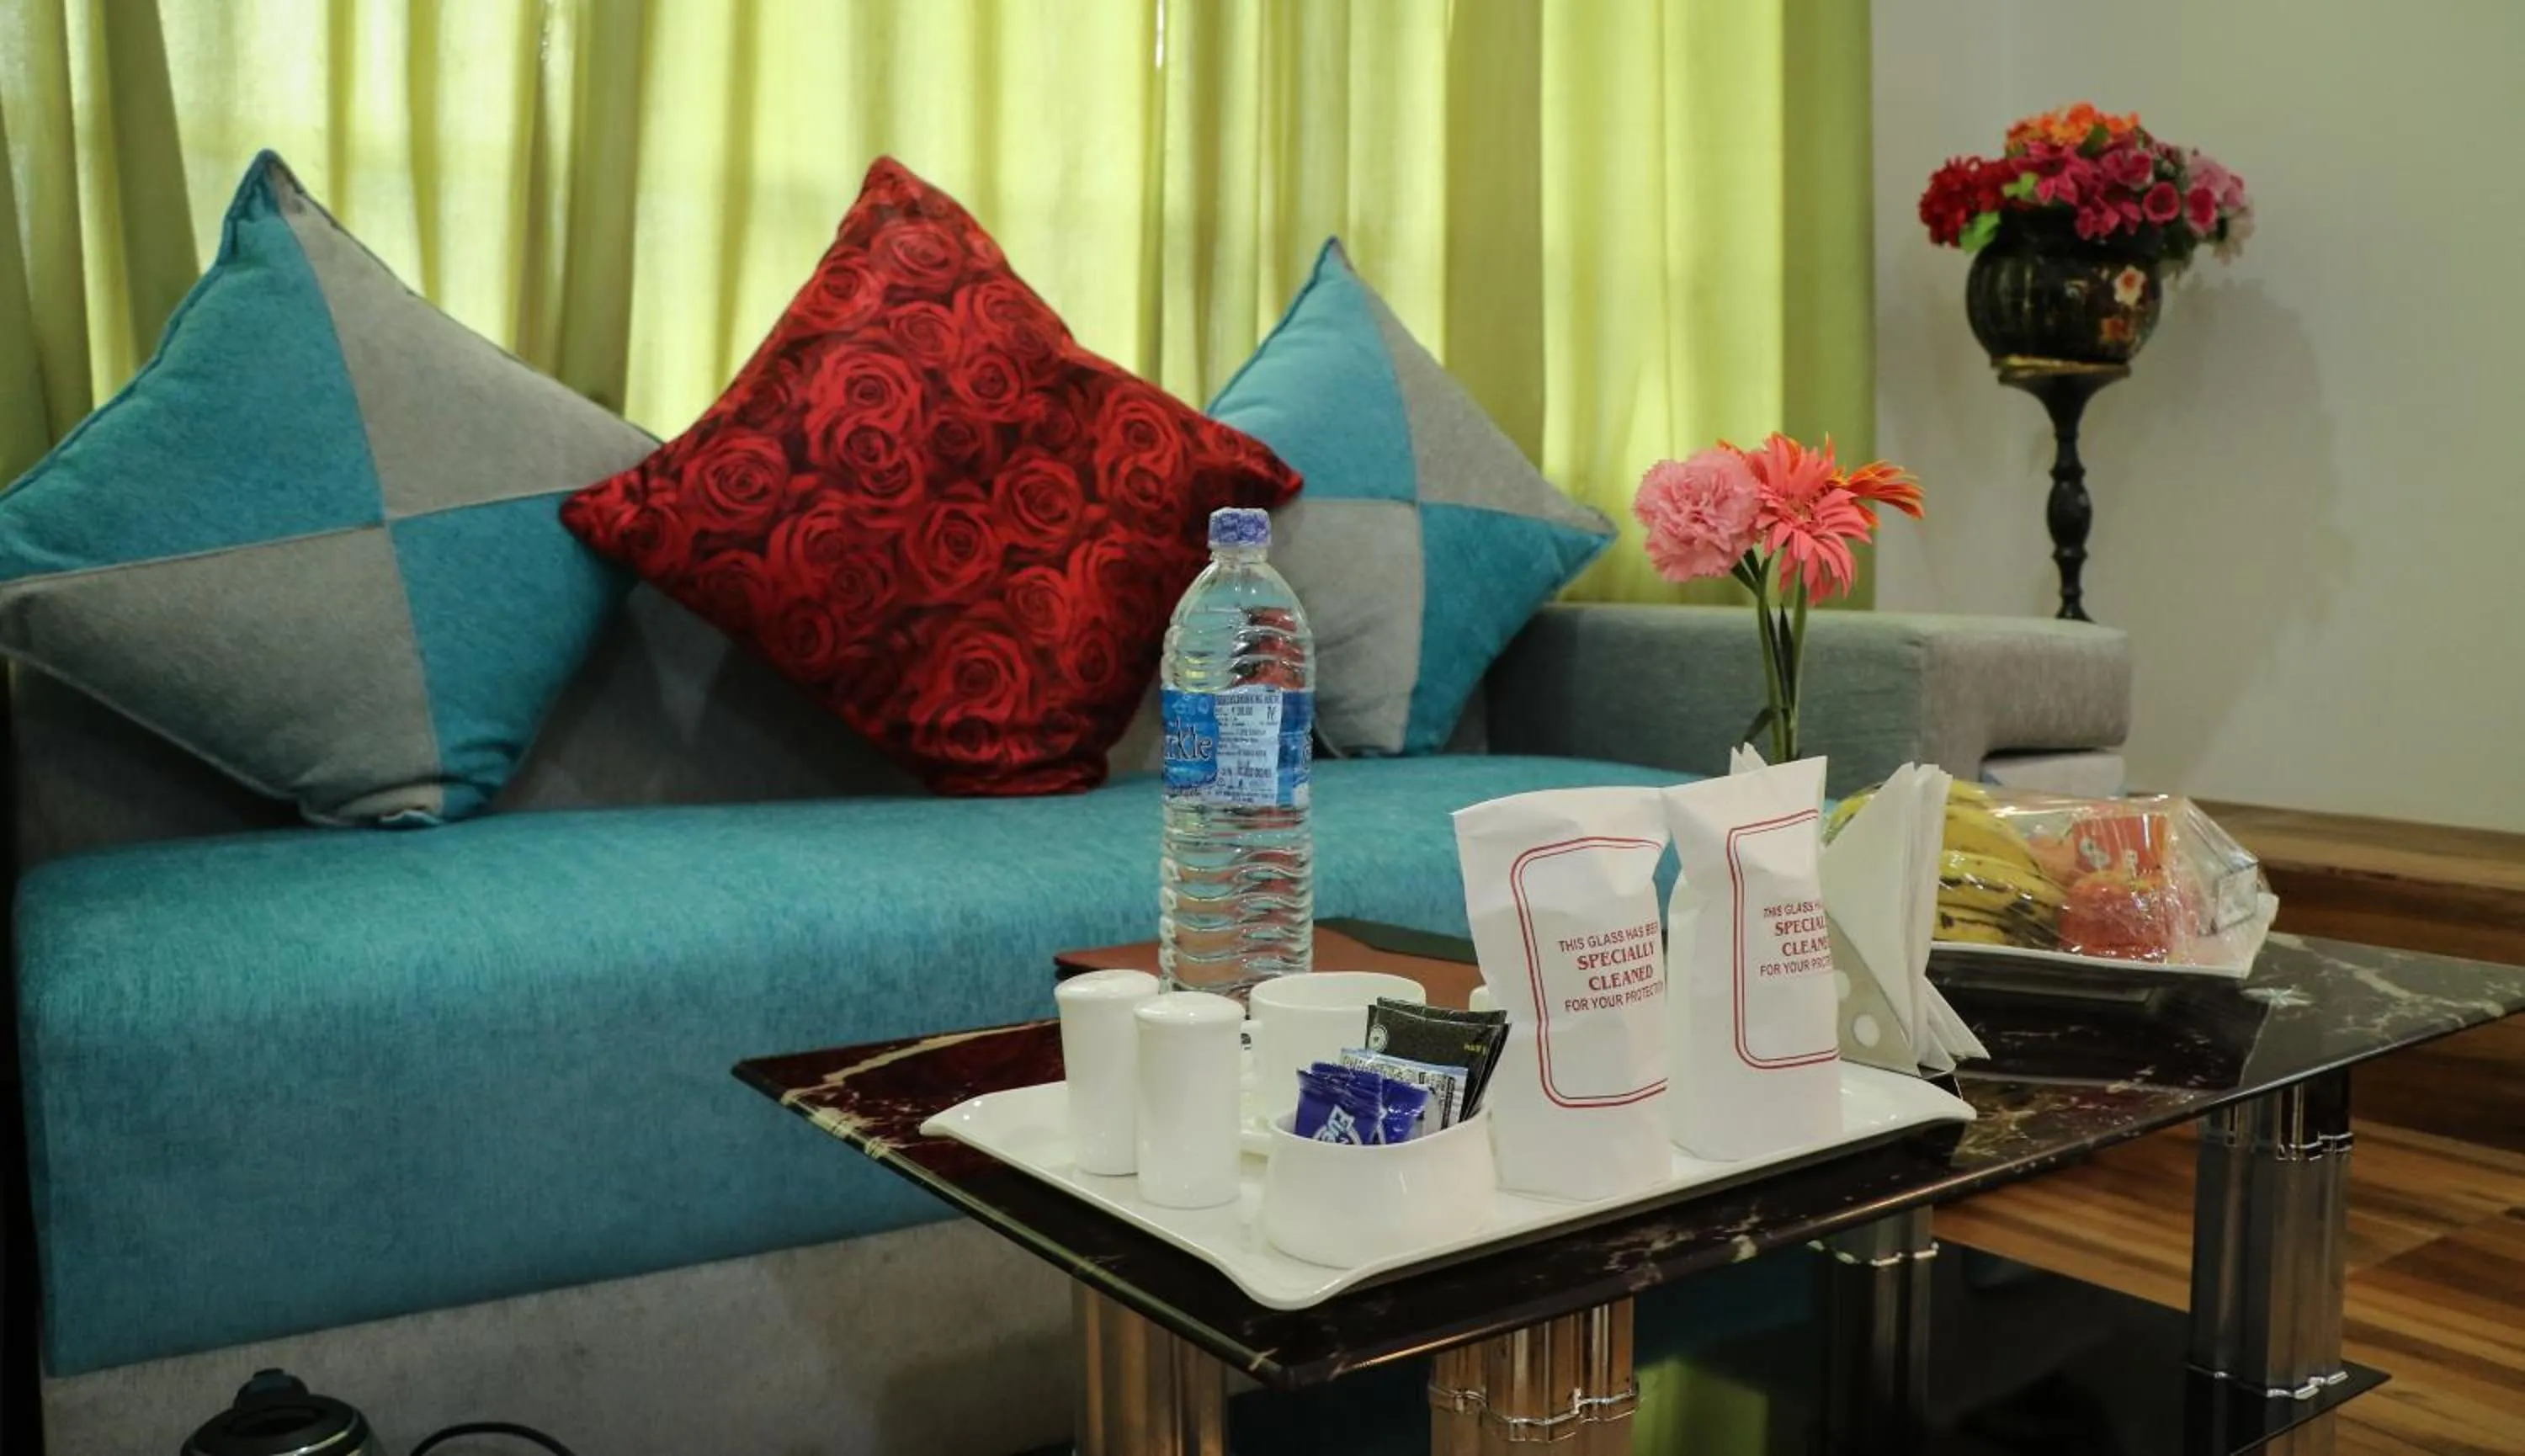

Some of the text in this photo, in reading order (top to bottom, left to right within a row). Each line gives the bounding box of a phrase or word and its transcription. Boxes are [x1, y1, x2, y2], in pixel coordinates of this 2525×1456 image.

[1763, 905, 1782, 917] THIS
[1783, 901, 1814, 916] GLASS
[1558, 937, 1585, 953] THIS
[1587, 929, 1624, 949] GLASS
[1625, 926, 1644, 941] HAS
[1576, 940, 1655, 970] SPECIALLY
[1588, 964, 1654, 991] CLEANED
[1760, 963, 1781, 976] FOR
[1783, 959, 1810, 975] YOUR
[1565, 998, 1590, 1012] FOR
[1591, 993, 1624, 1009] YOUR
